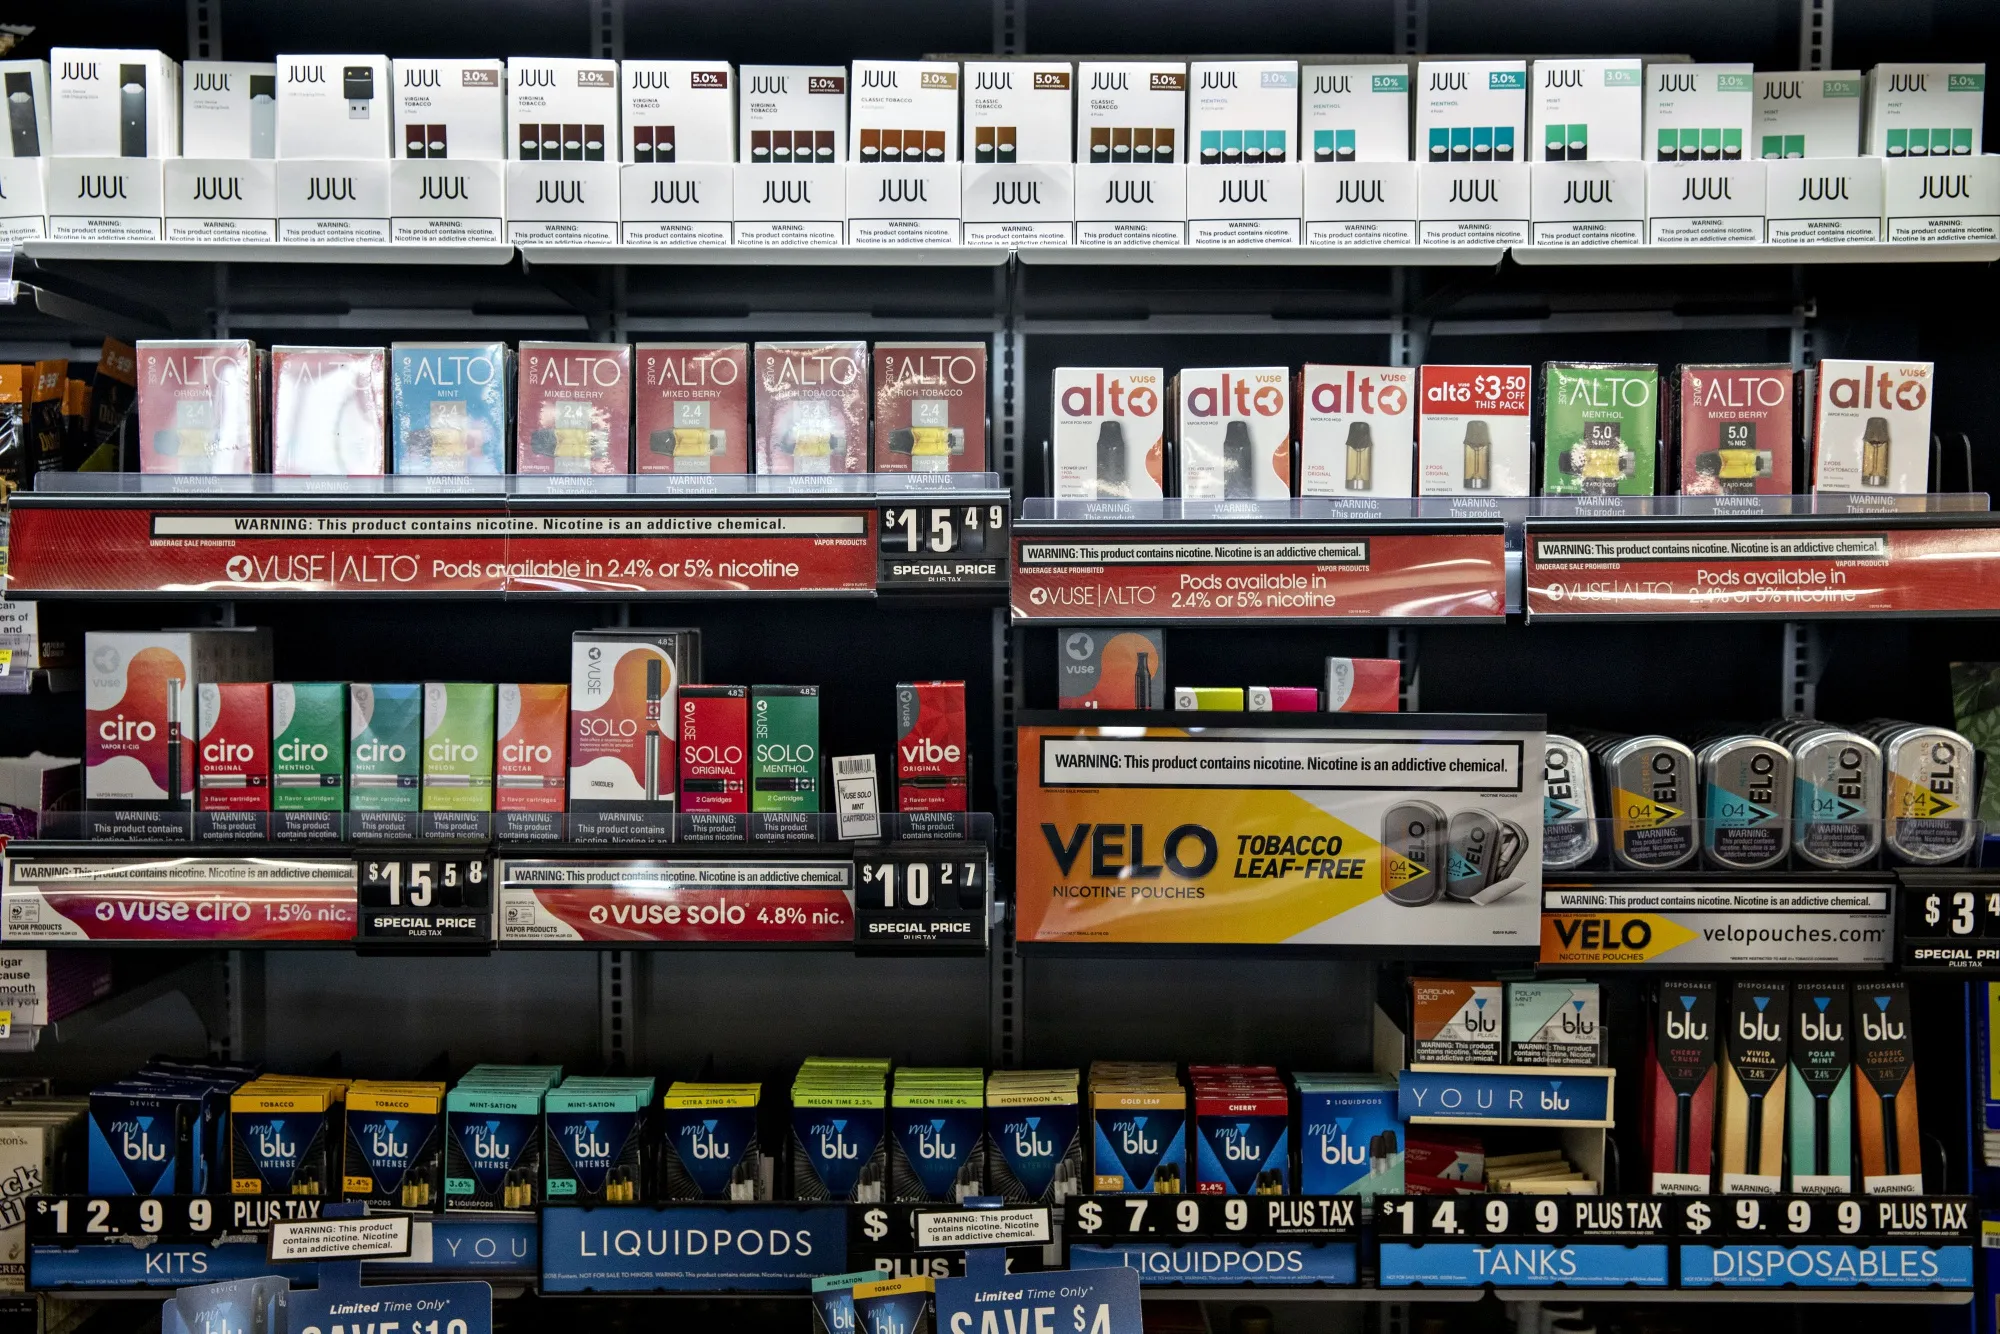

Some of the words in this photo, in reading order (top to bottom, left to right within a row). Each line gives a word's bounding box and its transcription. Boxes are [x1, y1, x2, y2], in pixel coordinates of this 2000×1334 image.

[404, 69, 441, 87] JUUL
[463, 71, 488, 82] 3.0%
[750, 76, 787, 94] JUUL
[1314, 76, 1351, 94] JUUL
[1374, 77, 1398, 87] 5.0%
[78, 175, 127, 199] JUUL
[879, 179, 927, 202] JUUL
[1441, 231, 1466, 240] product
[415, 355, 495, 387] ALTO
[896, 356, 976, 387] ALTO
[1129, 375, 1156, 383] vuse
[896, 387, 918, 397] RICH
[921, 389, 963, 397] TOBACCO
[1060, 373, 1158, 416] alto
[1427, 382, 1471, 402] alto
[1475, 376, 1526, 396] $3.50
[1506, 391, 1525, 400] OFF
[1570, 377, 1650, 407] ALTO
[682, 405, 702, 418] 2.4
[1475, 400, 1496, 409] THIS
[1499, 401, 1524, 409] PACK
[1581, 410, 1624, 419] MENTHOL
[1592, 426, 1612, 440] 5.0
[907, 475, 953, 485] WARNING:
[234, 519, 312, 530] WARNING:
[317, 519, 347, 530] This
[352, 519, 406, 533] product
[411, 519, 471, 530] contains
[477, 519, 537, 530] nicotine.
[543, 518, 603, 530] Nicotine
[609, 518, 620, 530] is
[625, 521, 641, 530] an
[647, 518, 712, 530] addictive
[717, 518, 785, 530] chemical.
[150, 539, 183, 547] UNDERAGE
[433, 560, 482, 578] Pods
[486, 559, 581, 578] available
[584, 559, 602, 577] in
[608, 559, 654, 578] 2.4%
[659, 563, 680, 577] or
[684, 559, 713, 577] 5%
[719, 559, 799, 577] nicotine
[893, 565, 951, 575] SPECIAL
[956, 565, 996, 574] PRICE
[100, 714, 156, 741] ciro
[204, 738, 254, 762] ciro
[685, 746, 742, 764] SOLO
[902, 742, 960, 763] vibe
[692, 766, 736, 775] ORIGINAL
[1055, 754, 1121, 768] WARNING:
[1124, 755, 1149, 768] This
[1152, 755, 1198, 772] product
[1200, 756, 1251, 770] contains
[1253, 756, 1304, 770] nicotine.
[1307, 757, 1358, 771] Nicotine
[1361, 757, 1371, 771] is
[1374, 761, 1388, 771] an
[1391, 757, 1446, 772] addictive
[1449, 758, 1507, 772] chemical.
[842, 791, 856, 800] VUSE
[857, 790, 872, 799] SOLO
[842, 812, 877, 823] CARTRIDGES
[1040, 822, 1218, 879] VELO
[1237, 835, 1342, 856] TOBACCO
[1233, 858, 1365, 879] LEAF-FREE
[1053, 886, 1126, 898] NICOTINE
[1131, 887, 1205, 899] POUCHES
[118, 902, 190, 921] vuse
[196, 897, 250, 922] ciro
[264, 904, 306, 922] 1.5%
[318, 904, 352, 922] nic.
[612, 904, 681, 925] vuse
[686, 896, 745, 925] solo
[757, 906, 806, 926] 4.8%
[813, 906, 845, 926] nic.
[374, 918, 432, 928] SPECIAL
[436, 918, 476, 928] PRICE
[1554, 919, 1652, 950] VELO
[1417, 988, 1455, 996] CAROLINA
[1738, 982, 1785, 991] DISPOSABLE
[1464, 1010, 1496, 1034] blu
[1740, 1012, 1781, 1041] blu
[1740, 1056, 1775, 1064] VANILLA
[260, 1133, 296, 1157] blu
[692, 1134, 730, 1159] blu
[1322, 1132, 1365, 1164] blu
[260, 1160, 295, 1168] INTENSE
[347, 1178, 369, 1186] 2.4%
[283, 1236, 319, 1244] contains
[322, 1234, 361, 1243] nicotine.
[363, 1232, 398, 1241] Nicotine
[290, 1226, 336, 1235] WARNING:
[338, 1224, 358, 1232] This
[359, 1223, 393, 1232] product
[310, 1243, 350, 1251] addictive
[352, 1240, 392, 1250] chemical.
[581, 1229, 812, 1257] LIQUIDPODS
[146, 1252, 207, 1274] KITS
[1472, 1249, 1576, 1276] TANKS
[1713, 1250, 1938, 1277] DISPOSABLES
[329, 1302, 380, 1315] Limited
[384, 1302, 412, 1312] Time
